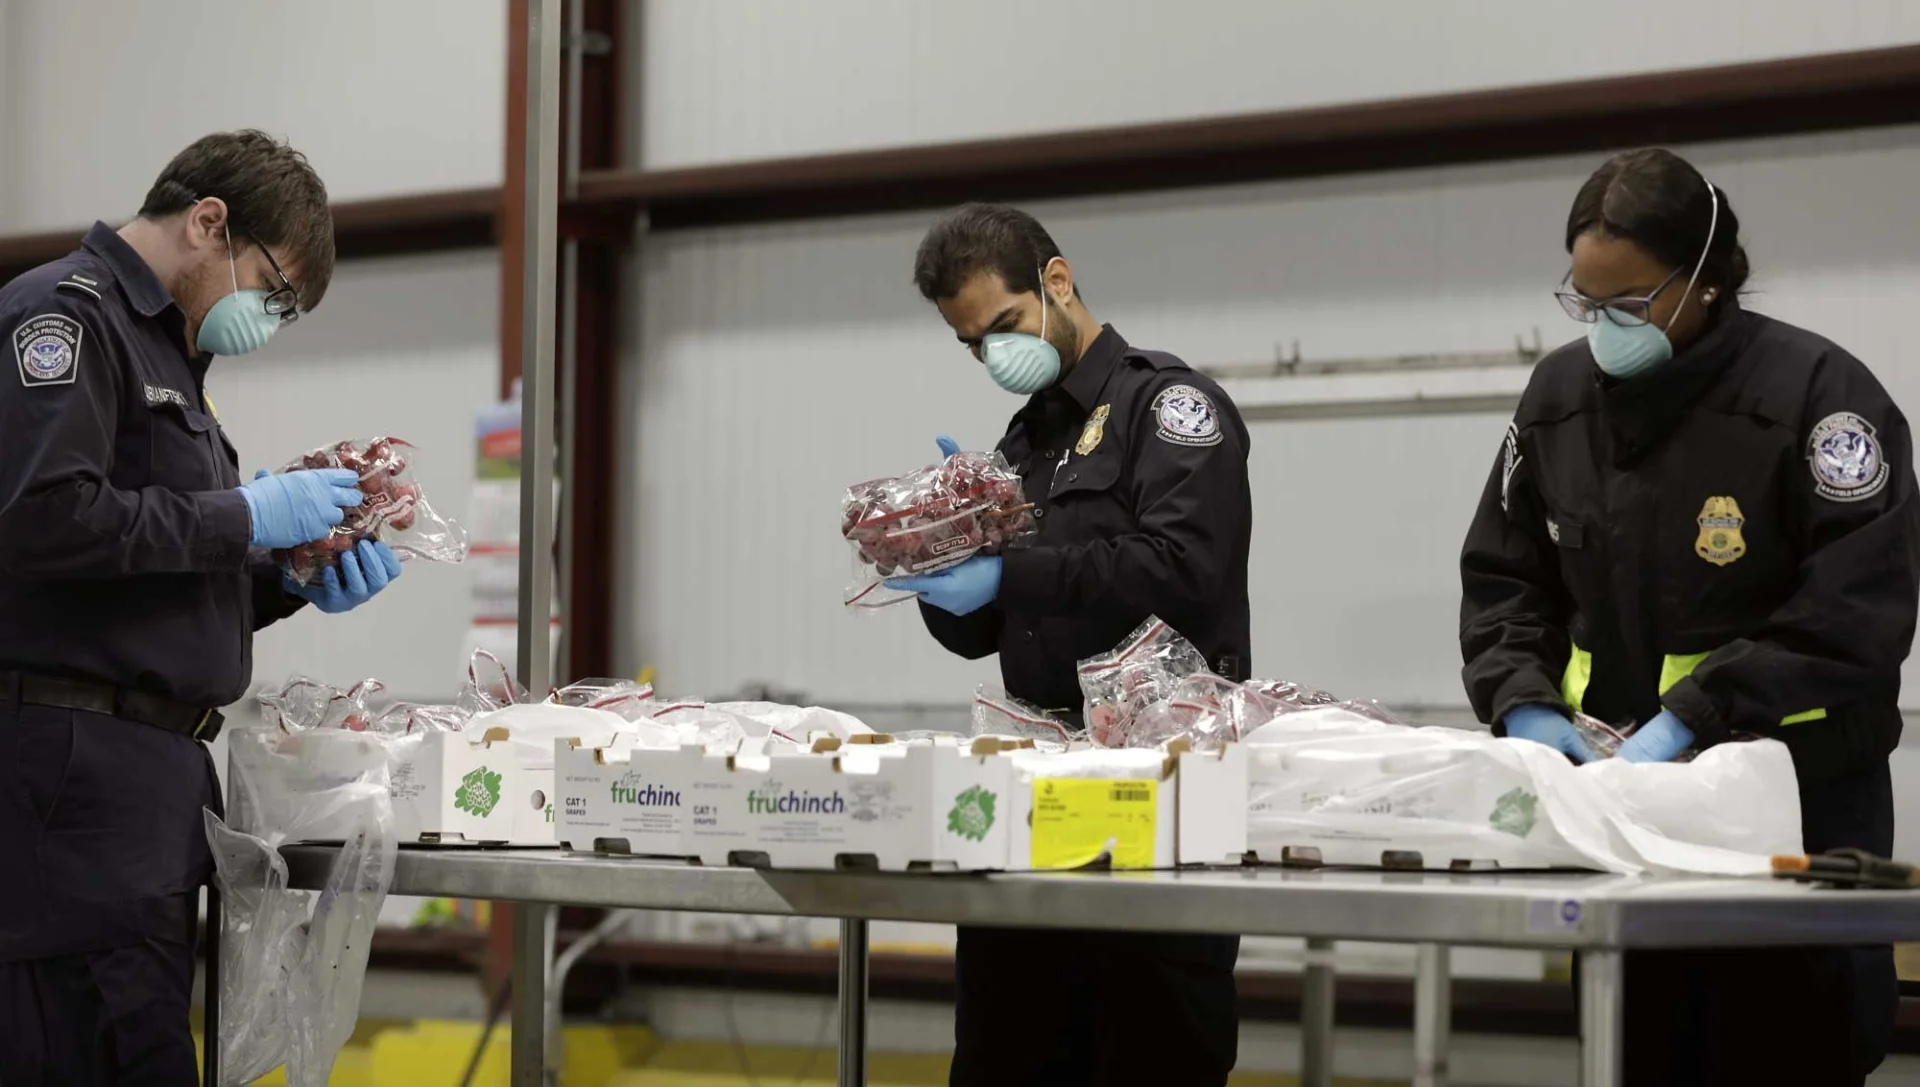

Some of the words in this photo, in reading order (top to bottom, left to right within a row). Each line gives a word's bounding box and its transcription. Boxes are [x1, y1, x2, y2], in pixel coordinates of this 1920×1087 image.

[33, 320, 64, 329] CUSTOMS
[19, 330, 40, 349] BORDER
[40, 327, 76, 345] PROTECTION
[566, 797, 581, 806] CAT
[582, 798, 587, 807] 1
[747, 790, 844, 814] fruchinch
[566, 808, 586, 816] GRAPES
[693, 805, 710, 815] CAT
